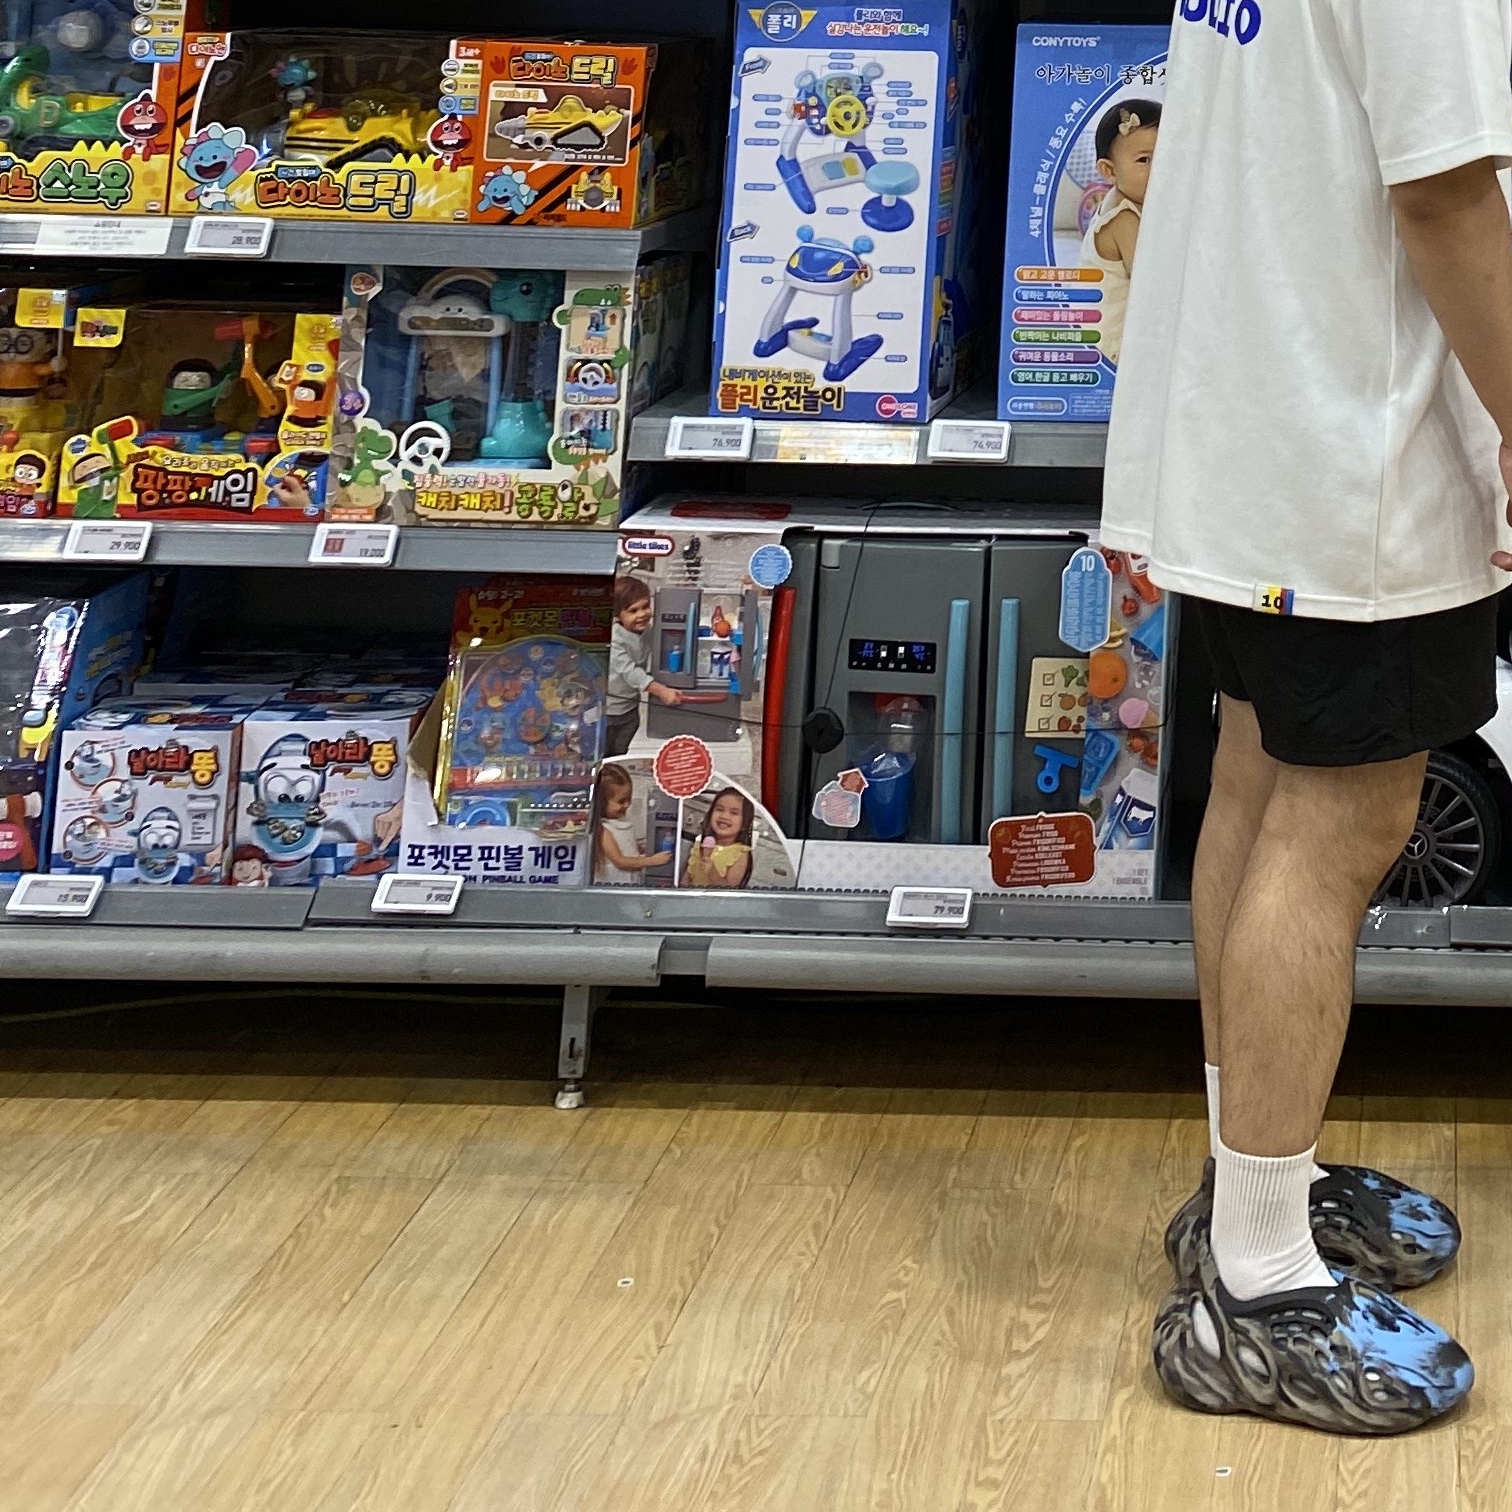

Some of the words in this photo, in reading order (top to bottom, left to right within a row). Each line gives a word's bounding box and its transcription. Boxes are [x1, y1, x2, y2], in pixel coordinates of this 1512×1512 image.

[766, 13, 797, 34] 폴리
[1032, 36, 1098, 47] CONYTOYS
[1035, 63, 1112, 86] 아가놀이
[39, 160, 132, 209] 스노우
[256, 175, 344, 206] 다이노
[345, 170, 416, 218] 드릴
[718, 383, 758, 412] 폴리
[759, 384, 844, 412] 운전놀이
[1080, 554, 1096, 571] 10
[1261, 594, 1284, 609] 10
[408, 844, 472, 871] 포켓몬
[477, 844, 524, 871] 핀볼
[527, 845, 577, 871] 게임
[482, 875, 525, 885] PINBALL
[528, 875, 559, 885] GAME
